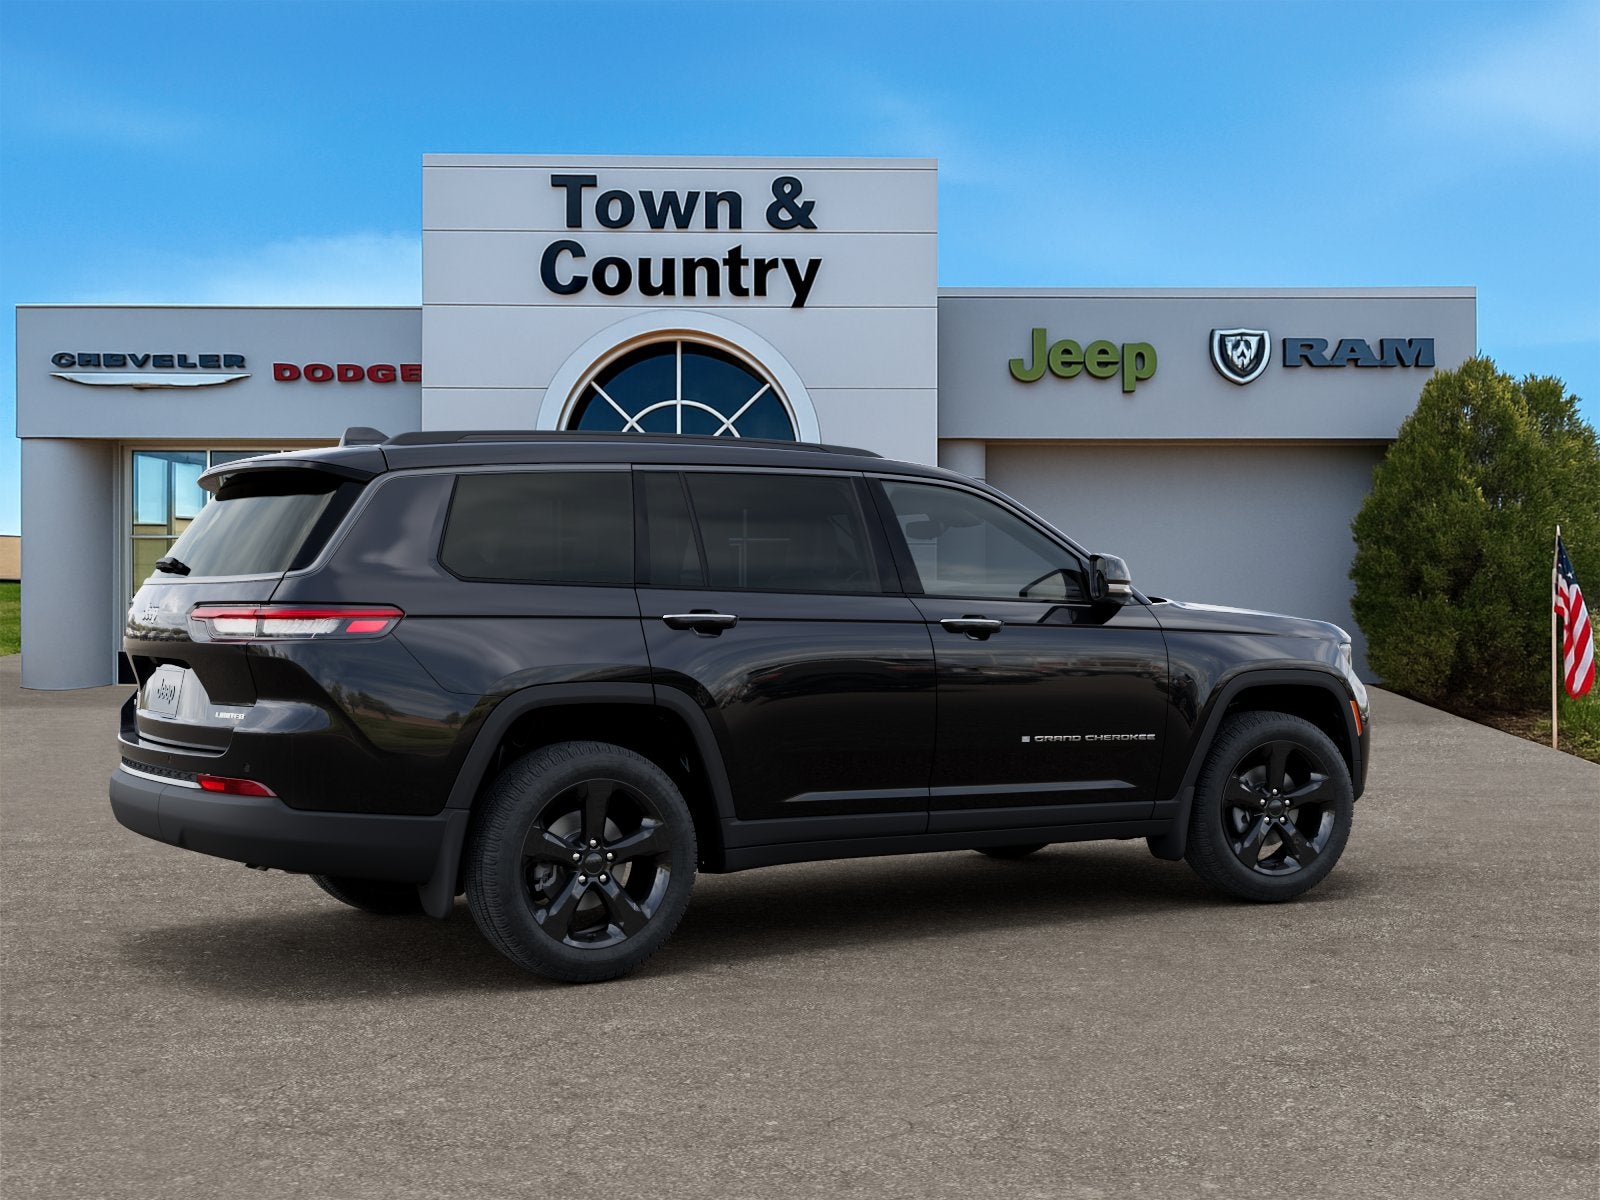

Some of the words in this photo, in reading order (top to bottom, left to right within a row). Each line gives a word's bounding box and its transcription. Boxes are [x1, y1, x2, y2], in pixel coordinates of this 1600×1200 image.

[550, 174, 742, 229] Town
[765, 176, 818, 229] &
[540, 239, 822, 308] Country
[273, 363, 422, 383] DODGE
[1009, 328, 1157, 392] Jeep
[1283, 338, 1435, 367] RAM
[1085, 733, 1156, 741] CHEROKEE
